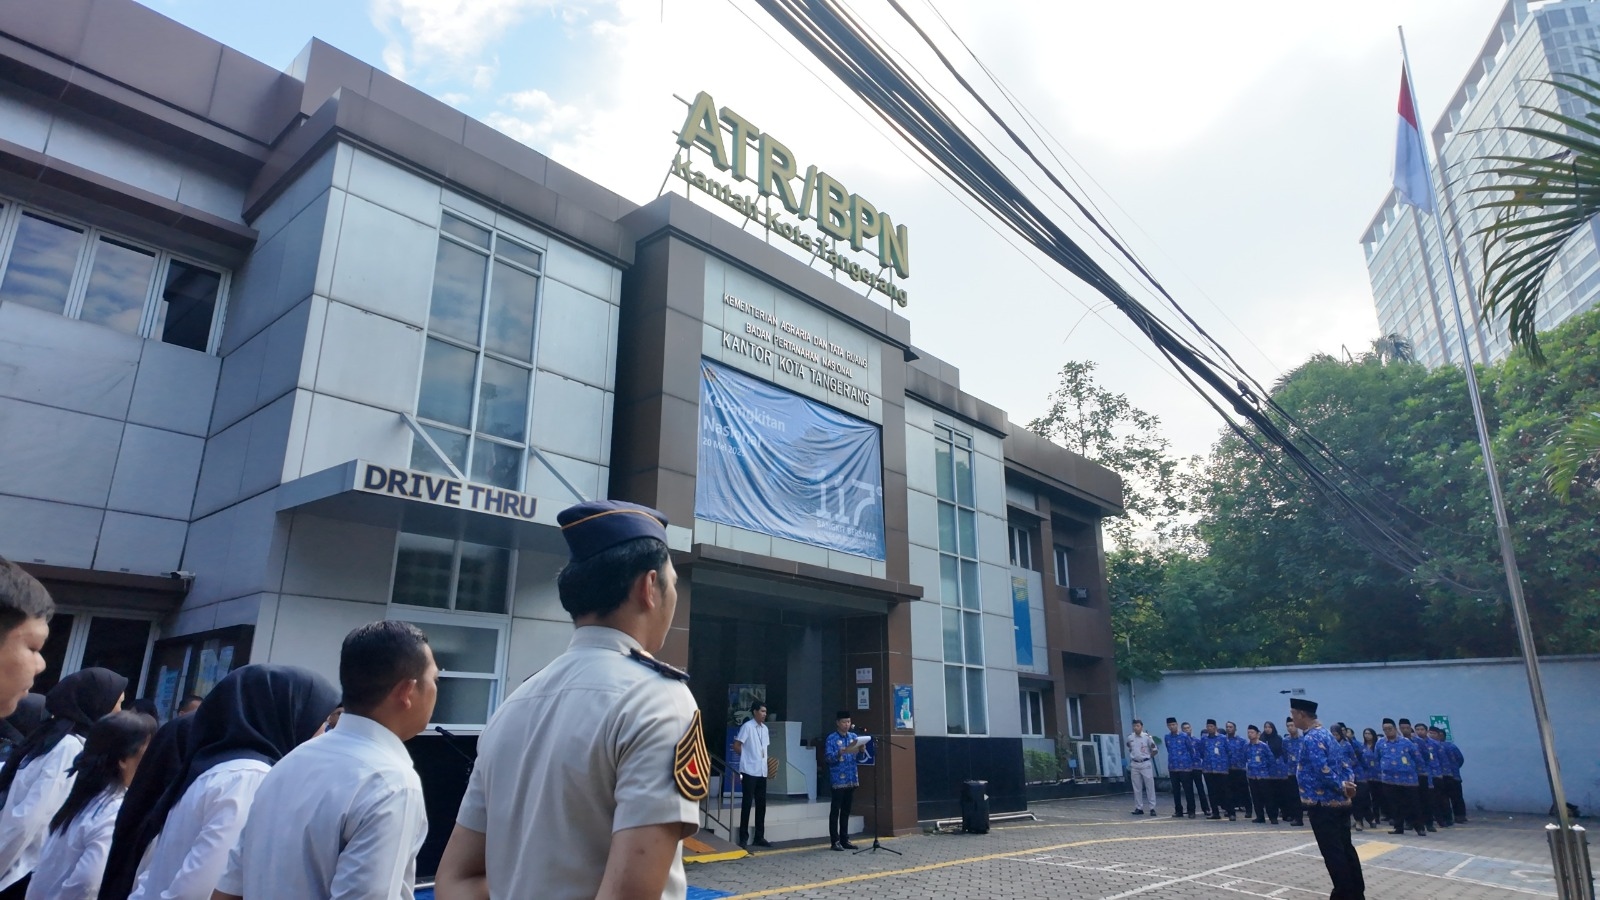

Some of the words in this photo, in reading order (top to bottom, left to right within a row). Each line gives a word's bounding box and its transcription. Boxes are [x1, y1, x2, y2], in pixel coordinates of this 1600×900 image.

[676, 91, 909, 279] ATR/BPN
[674, 153, 759, 219] Kantah
[766, 207, 813, 251] Kota
[816, 236, 907, 308] Tangerang
[723, 292, 778, 326] KEMENTERIAN
[780, 320, 811, 342] AGRARIA
[813, 335, 828, 350] DAN
[829, 342, 844, 358] TATA
[846, 352, 868, 369] RUANG
[745, 322, 771, 342] BADAN
[773, 334, 818, 363] PERTANAHAN
[821, 357, 853, 379] NASONAL
[722, 331, 772, 366] KANTOR
[778, 355, 805, 380] KOTA
[810, 367, 871, 407] TANGERANG
[702, 437, 712, 447] 20
[363, 464, 463, 506] DRIVE
[467, 485, 537, 519] THRU
